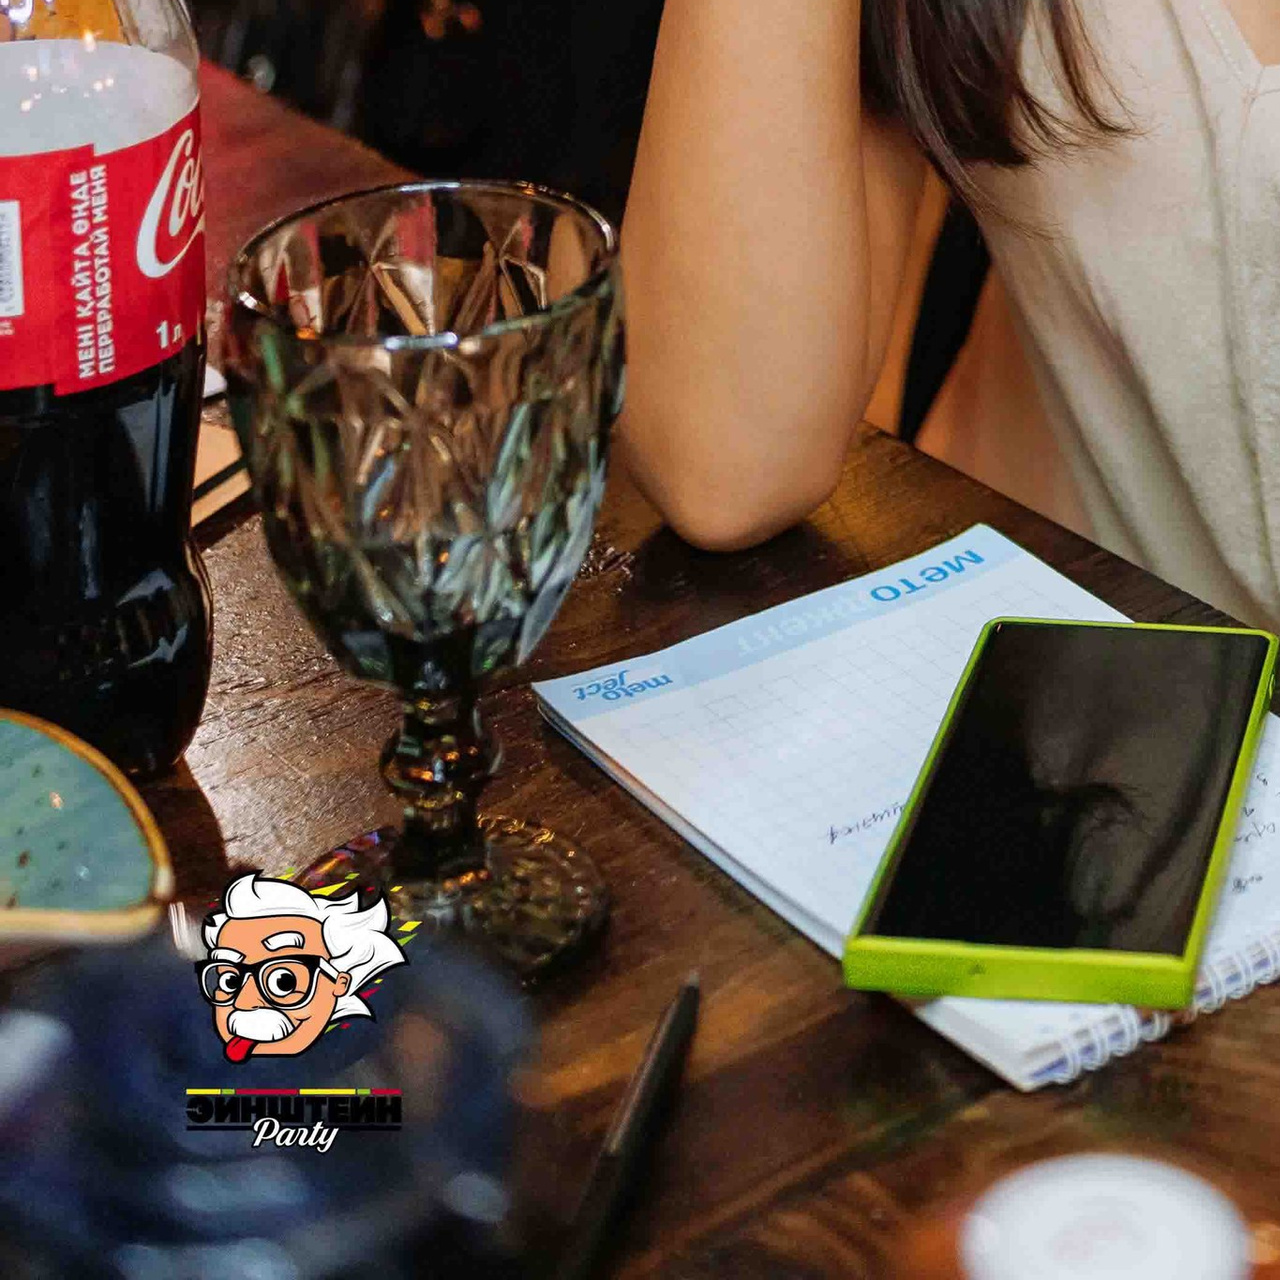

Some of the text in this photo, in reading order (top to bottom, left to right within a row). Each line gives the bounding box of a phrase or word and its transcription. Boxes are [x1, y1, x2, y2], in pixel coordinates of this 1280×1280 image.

[89, 163, 116, 375] ПЕРЕРАБОТАЙ МЕНЯ
[76, 322, 97, 380] МЕНІ
